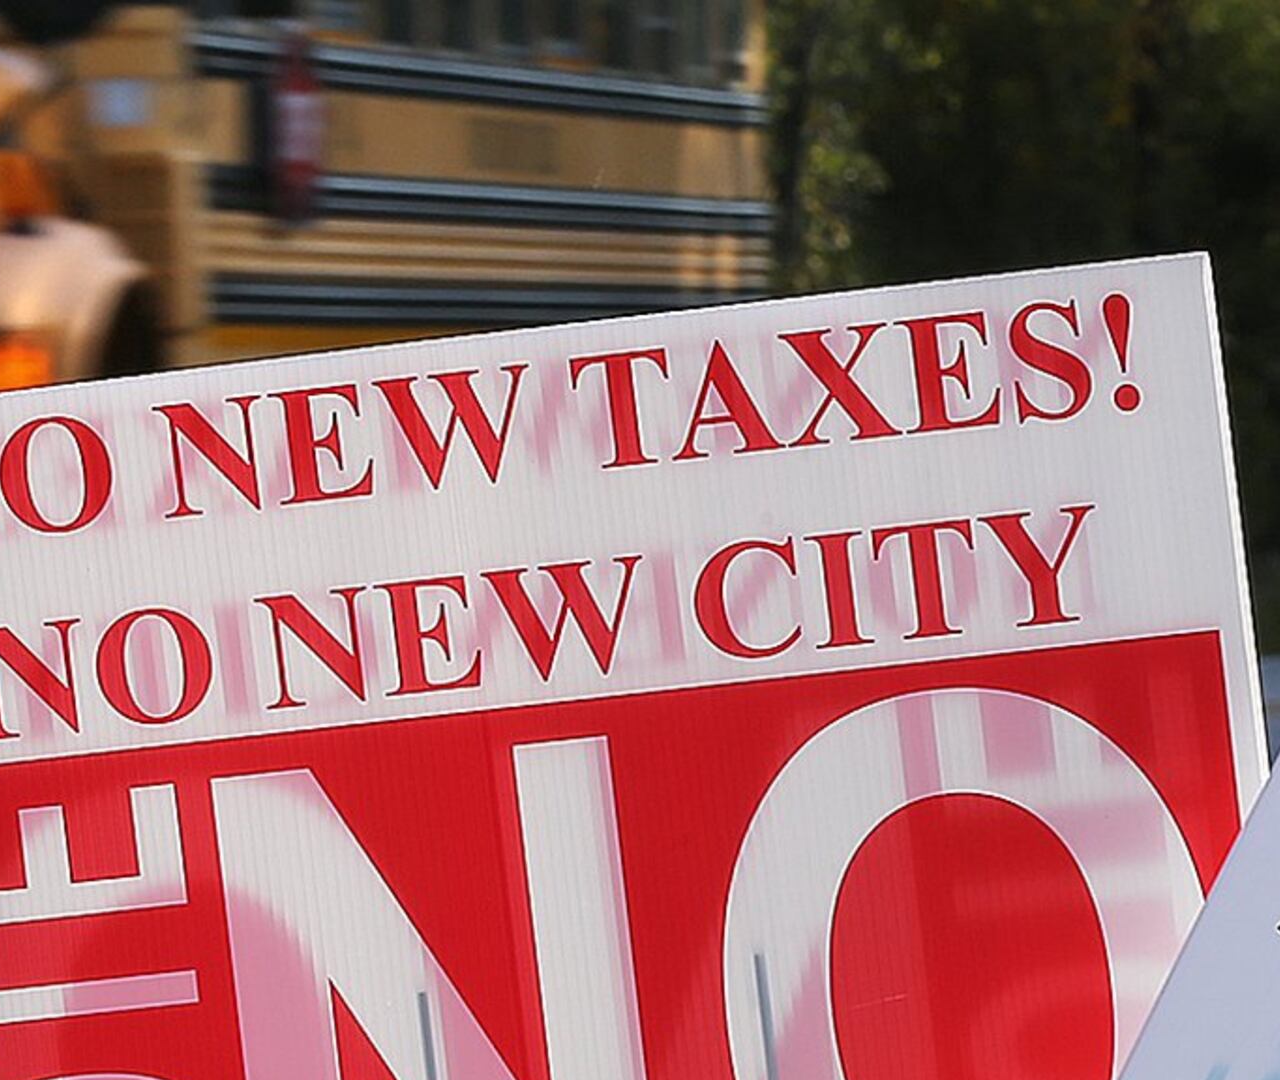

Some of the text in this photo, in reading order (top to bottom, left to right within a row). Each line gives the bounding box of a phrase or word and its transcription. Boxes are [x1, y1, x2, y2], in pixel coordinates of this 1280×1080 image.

[151, 364, 530, 519] NEW
[569, 293, 1142, 469] TAXES!
[255, 556, 642, 710] NEW
[693, 504, 1096, 660] CITY
